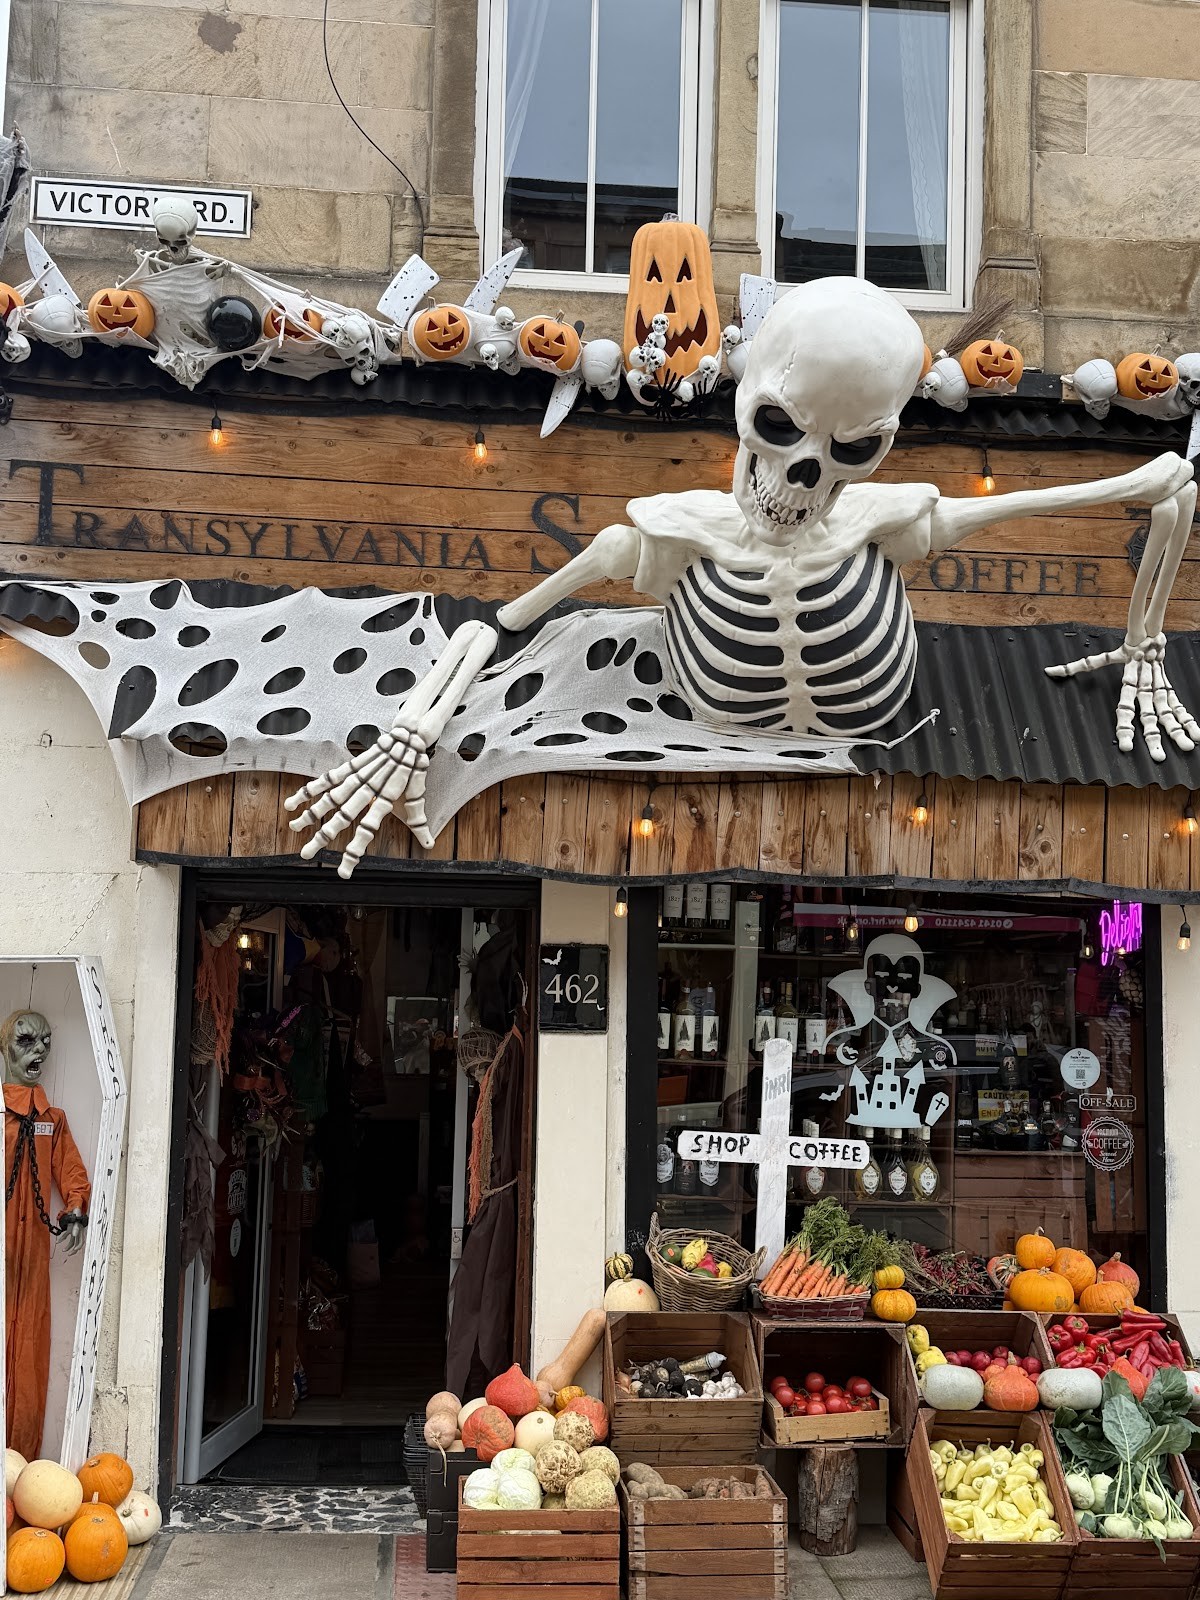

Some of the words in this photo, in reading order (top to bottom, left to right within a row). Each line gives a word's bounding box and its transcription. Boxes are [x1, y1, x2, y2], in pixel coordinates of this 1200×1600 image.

[49, 190, 158, 218] VICTOR
[195, 200, 235, 224] RD.
[905, 554, 1100, 597] OFFEE
[544, 974, 599, 1004] 462
[1081, 1097, 1134, 1108] OFF-SALE
[690, 1133, 750, 1156] SHOP
[789, 1141, 863, 1163] COFFEE
[1093, 1137, 1123, 1149] COFFEE
